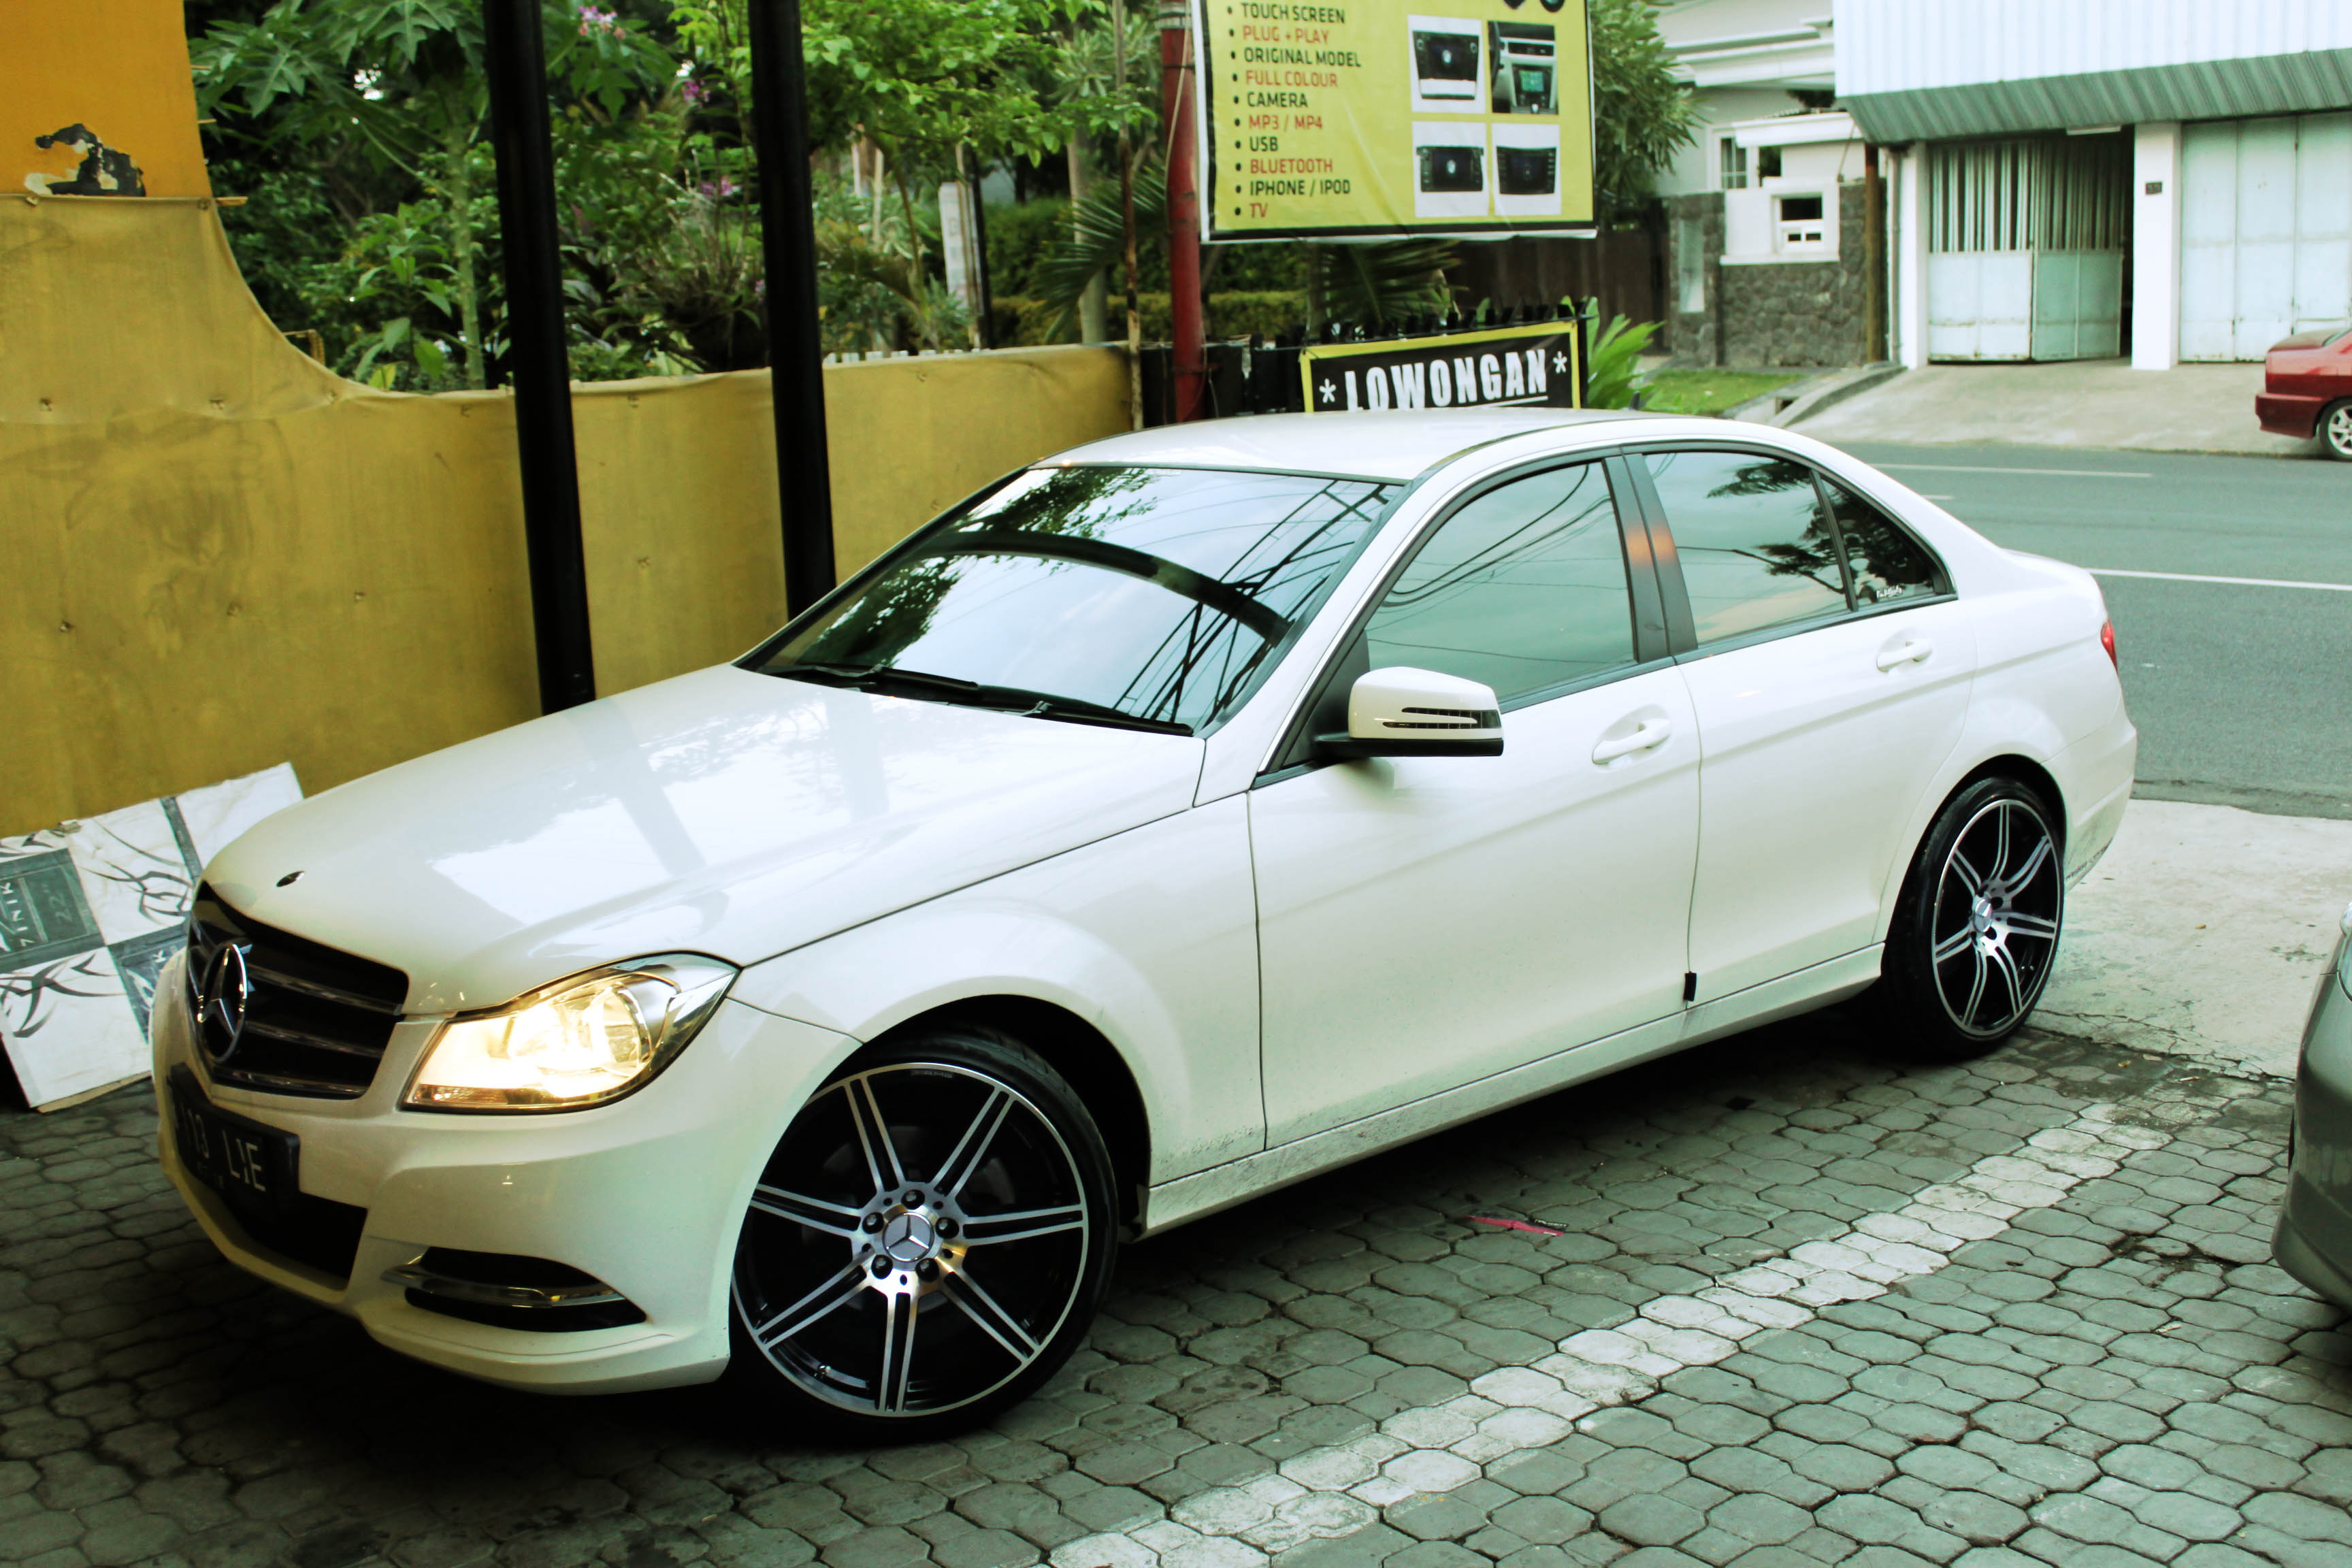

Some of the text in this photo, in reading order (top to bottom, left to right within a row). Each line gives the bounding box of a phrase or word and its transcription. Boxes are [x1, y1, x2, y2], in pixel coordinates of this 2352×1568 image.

[1242, 2, 1345, 24] TOUCH SCREEN
[1243, 25, 1279, 42] PLUG
[1295, 29, 1329, 44] PLAY
[1244, 47, 1361, 67] ORIGINAL MODEL
[1245, 70, 1338, 87] FULL COLOUR
[1247, 91, 1308, 108] CAMERA
[1249, 114, 1279, 130] MP3
[1294, 114, 1323, 130] MP4
[1250, 135, 1279, 152] USB
[1250, 158, 1333, 174] BLUETOOTH
[1250, 180, 1305, 196] IPHONE
[1320, 179, 1350, 195] IPOD
[1250, 203, 1268, 218] TV
[1345, 349, 1547, 412] LOWONGAN
